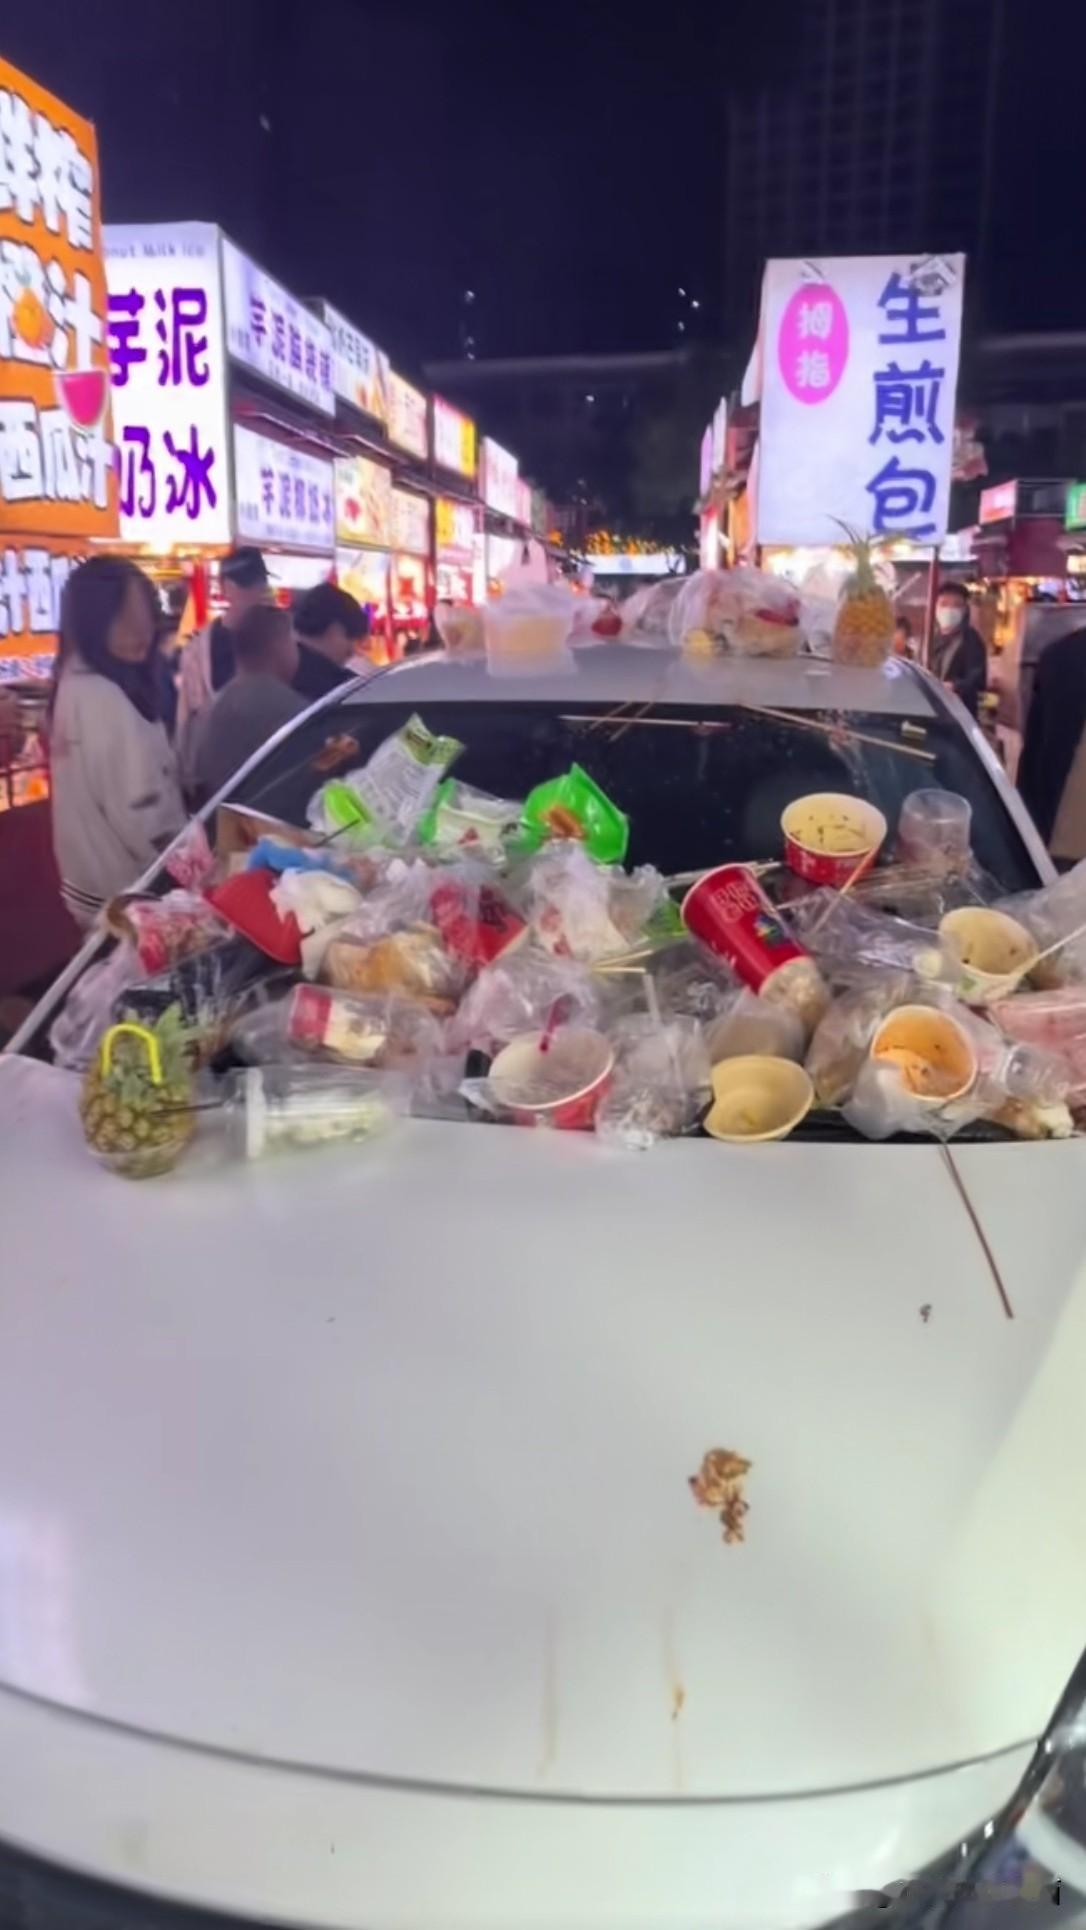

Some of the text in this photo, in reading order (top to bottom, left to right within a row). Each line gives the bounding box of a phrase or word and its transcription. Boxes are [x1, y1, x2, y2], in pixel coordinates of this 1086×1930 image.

[107, 287, 209, 387] 芋泥
[797, 300, 833, 388] 拇指
[0, 396, 116, 510] 西瓜汁
[866, 271, 946, 541] 生煎包
[119, 423, 217, 520] 奶冰
